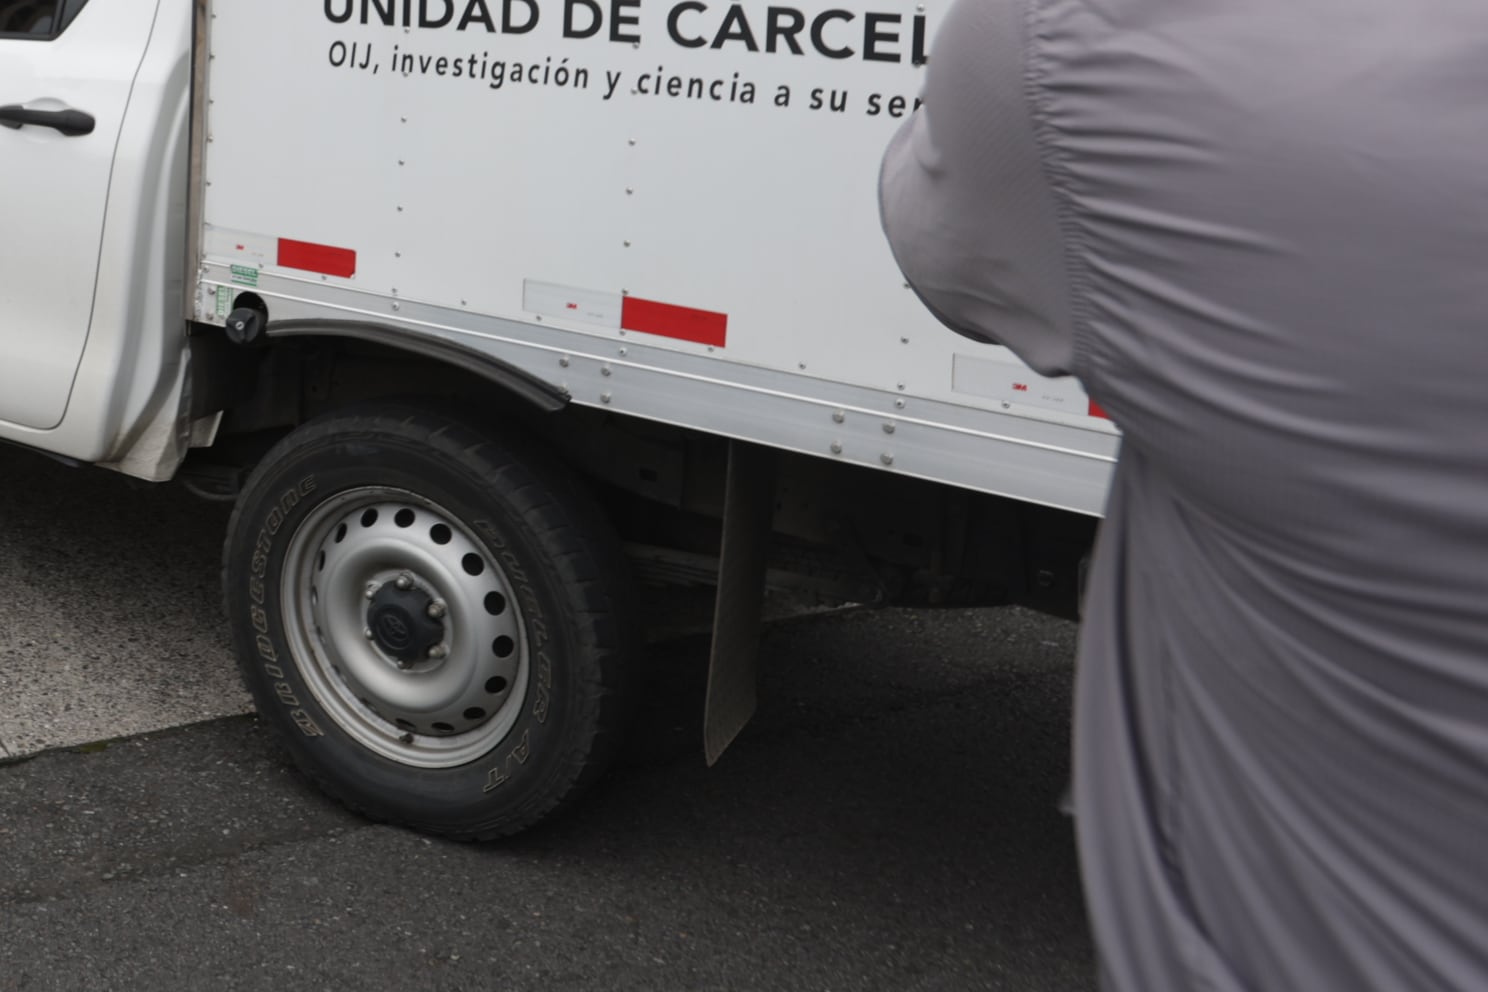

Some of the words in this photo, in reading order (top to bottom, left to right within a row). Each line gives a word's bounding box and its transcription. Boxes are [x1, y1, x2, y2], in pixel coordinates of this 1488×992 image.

[328, 40, 379, 74] OIJ,
[391, 48, 588, 90] investigación
[603, 71, 621, 100] y
[637, 68, 756, 104] ciencia
[774, 85, 790, 107] a
[809, 88, 848, 113] su
[1012, 383, 1027, 392] 3M
[249, 473, 325, 739] BRIDGESTONE
[482, 728, 531, 792] A/T
